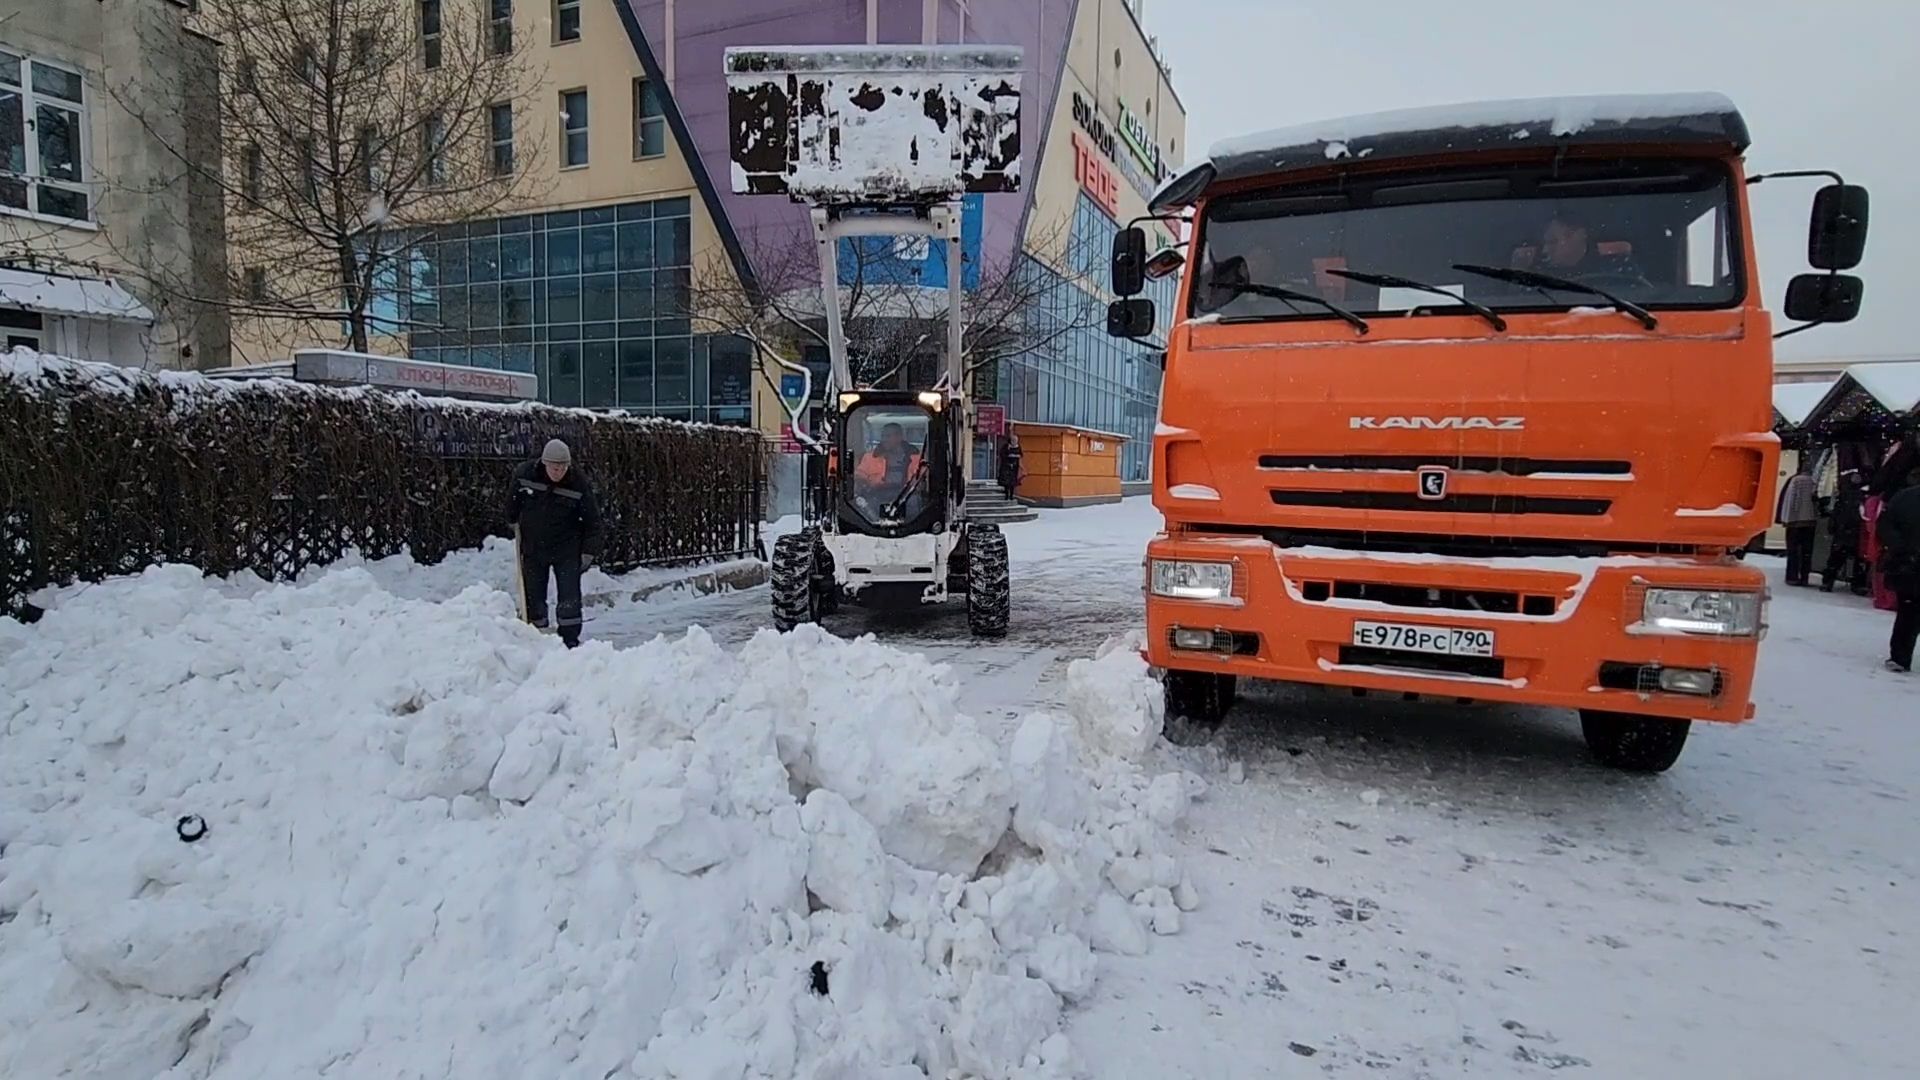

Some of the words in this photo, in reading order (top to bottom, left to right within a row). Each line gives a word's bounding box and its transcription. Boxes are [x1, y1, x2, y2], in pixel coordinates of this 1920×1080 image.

[396, 366, 452, 385] КЛЮЧИ
[458, 374, 519, 391] ЗАТОЧКА
[1350, 416, 1525, 429] KAMAZ
[1360, 626, 1447, 650] Е978РС
[1453, 630, 1487, 647] 790
